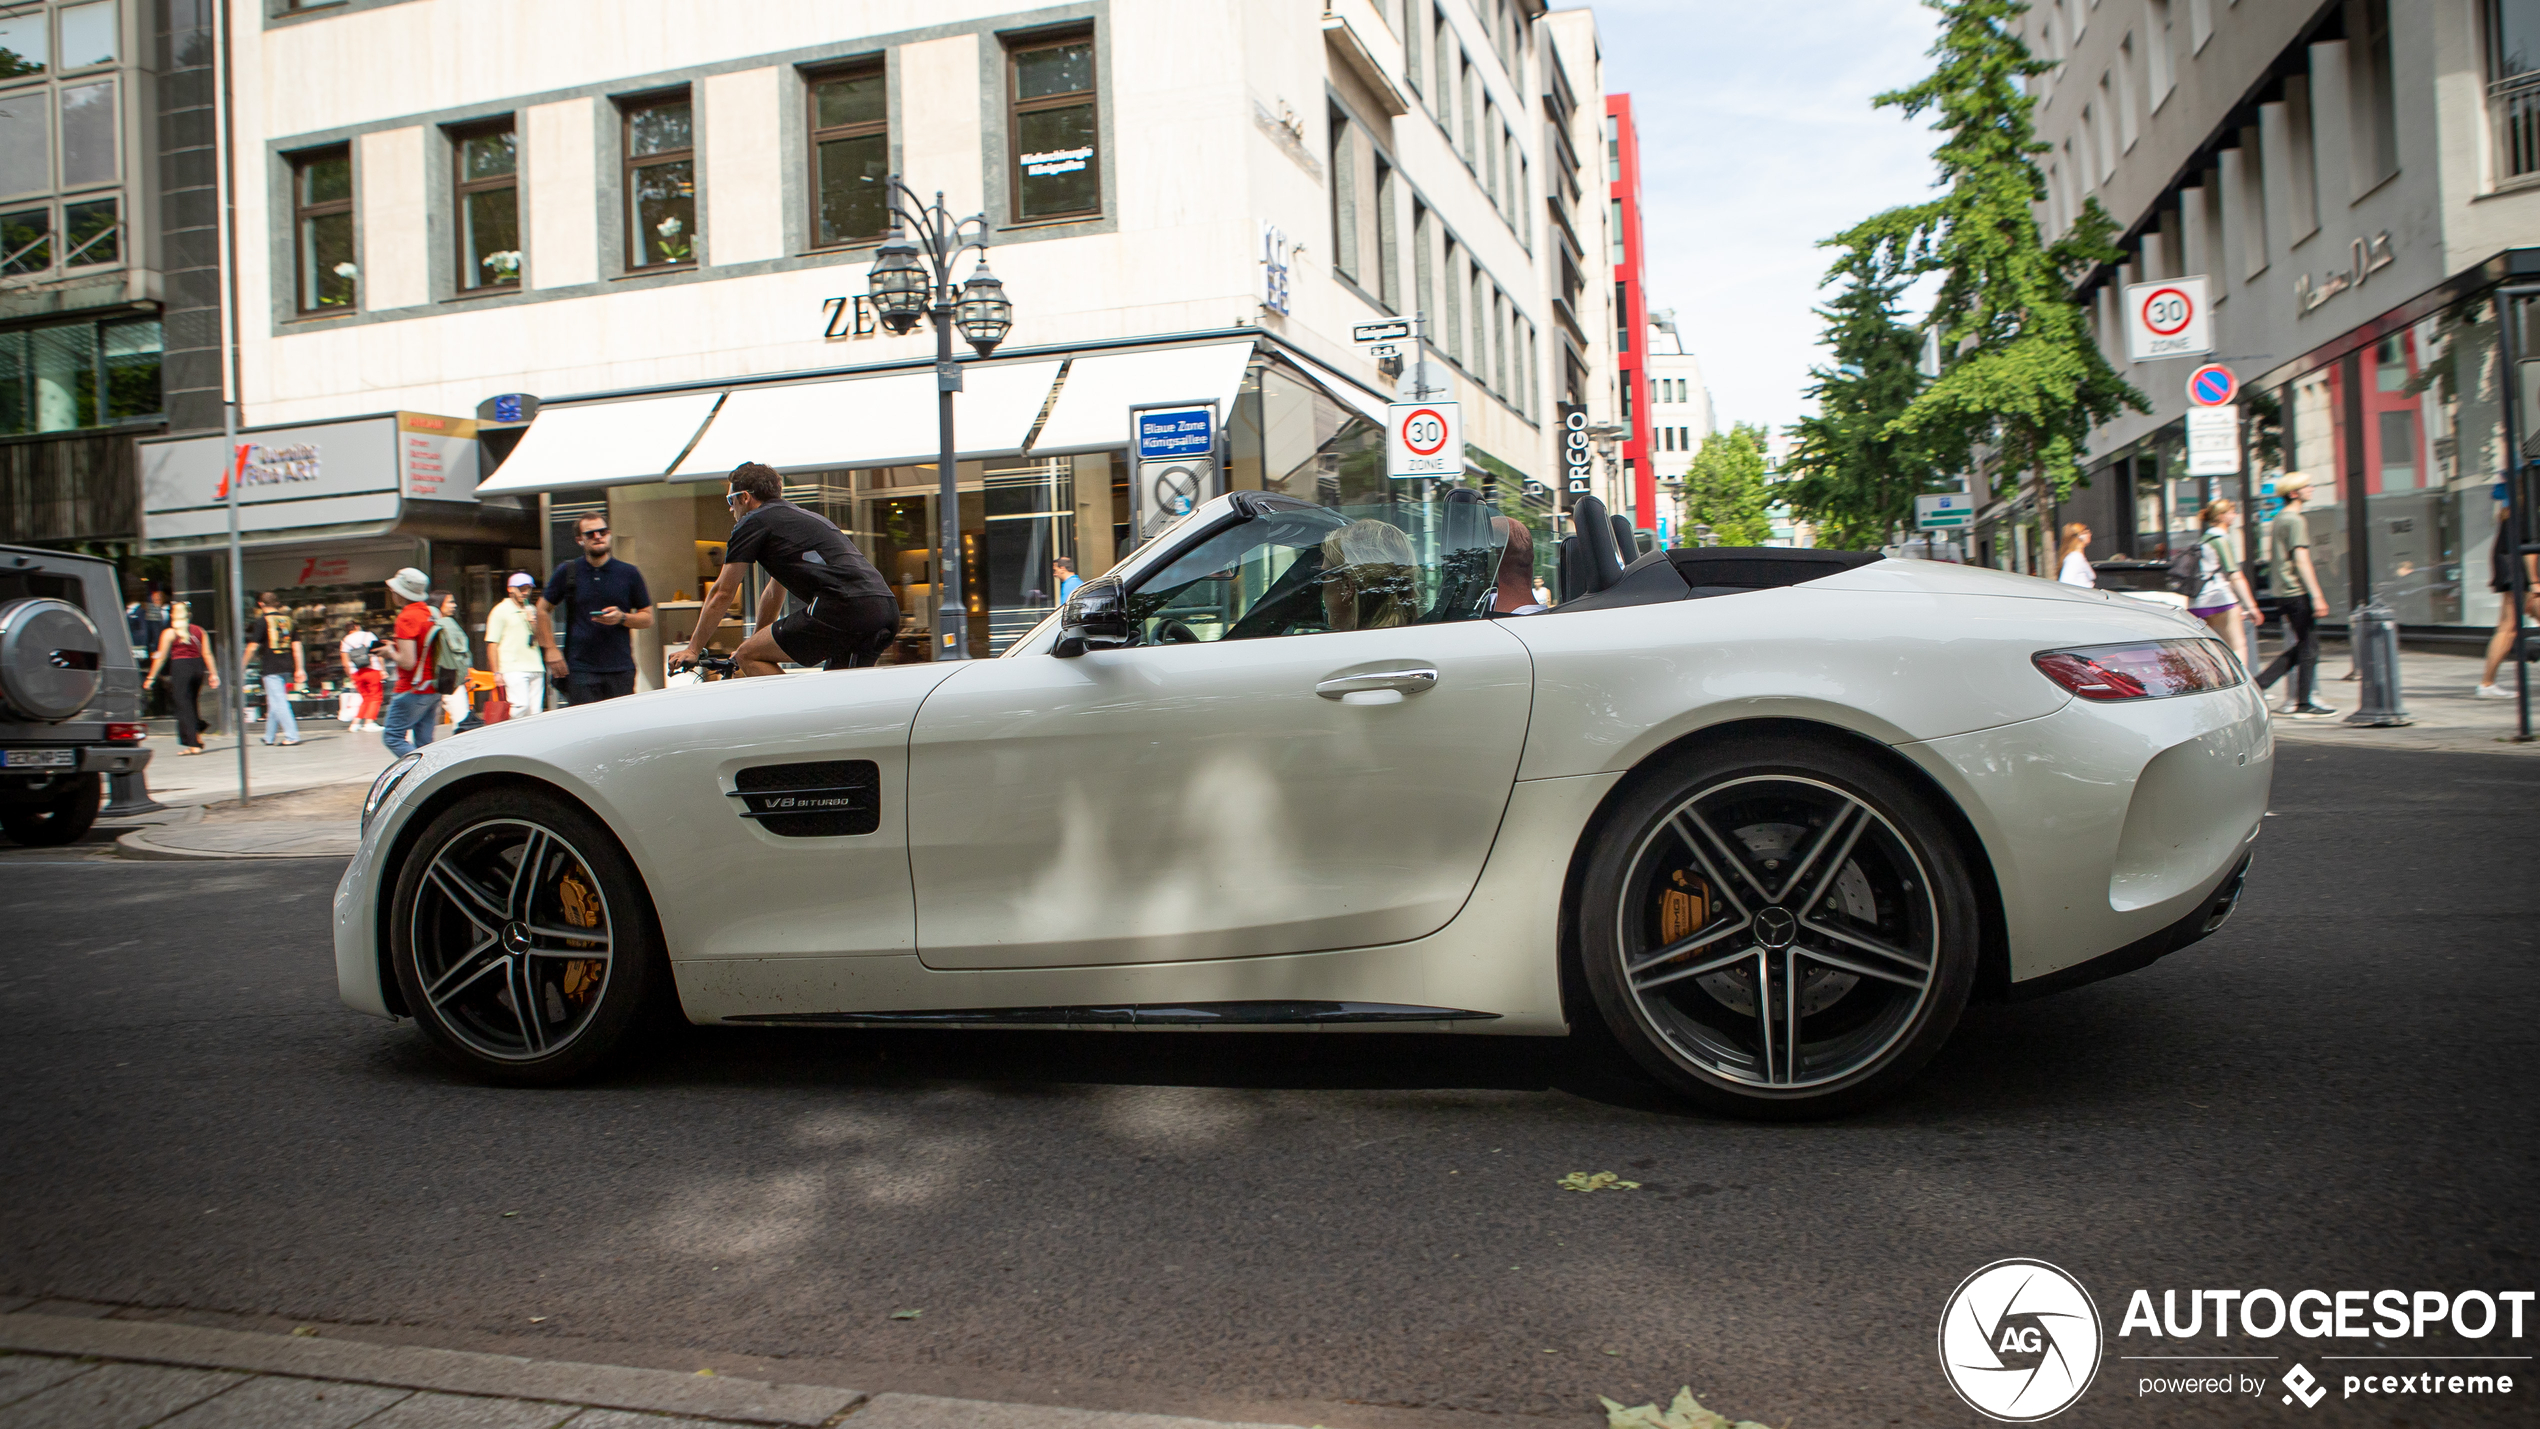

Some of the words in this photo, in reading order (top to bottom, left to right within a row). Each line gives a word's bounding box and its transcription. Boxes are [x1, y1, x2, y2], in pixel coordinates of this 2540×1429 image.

[2152, 300, 2184, 324] 30
[2149, 337, 2191, 353] ZONE
[1143, 423, 1176, 434] Blaue
[1177, 420, 1206, 432] Zone
[1411, 421, 1438, 443] 30
[1142, 434, 1208, 449] Königsallee
[1566, 411, 1591, 493] PREGO
[1408, 458, 1445, 471] ZONE
[765, 798, 795, 808] V8
[797, 798, 849, 807] BITURBO
